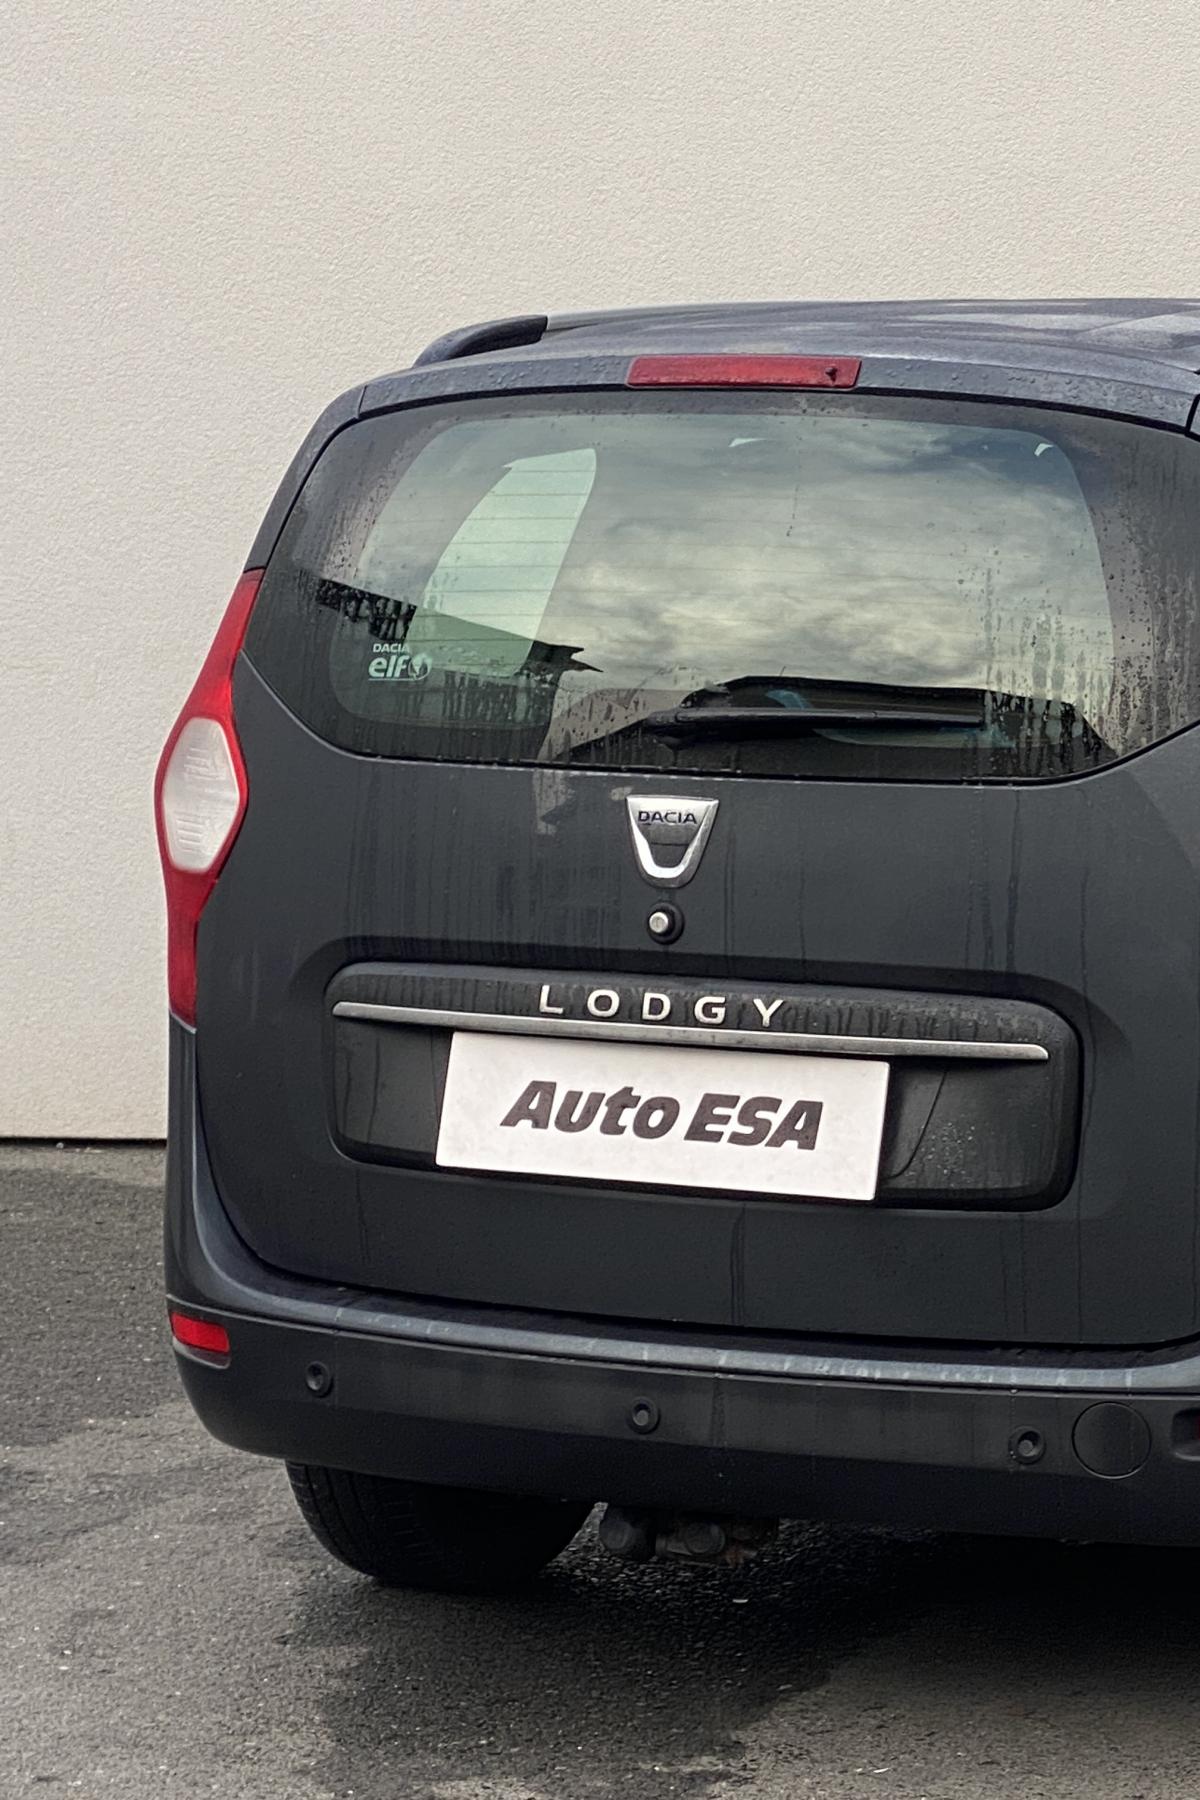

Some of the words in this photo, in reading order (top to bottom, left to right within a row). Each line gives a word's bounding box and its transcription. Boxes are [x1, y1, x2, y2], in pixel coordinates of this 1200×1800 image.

[373, 643, 410, 653] DACIA
[368, 655, 410, 678] elf
[638, 811, 697, 825] DACIA
[539, 985, 784, 1028] LODGY
[500, 1080, 680, 1140] Auto
[684, 1093, 823, 1151] ESA
